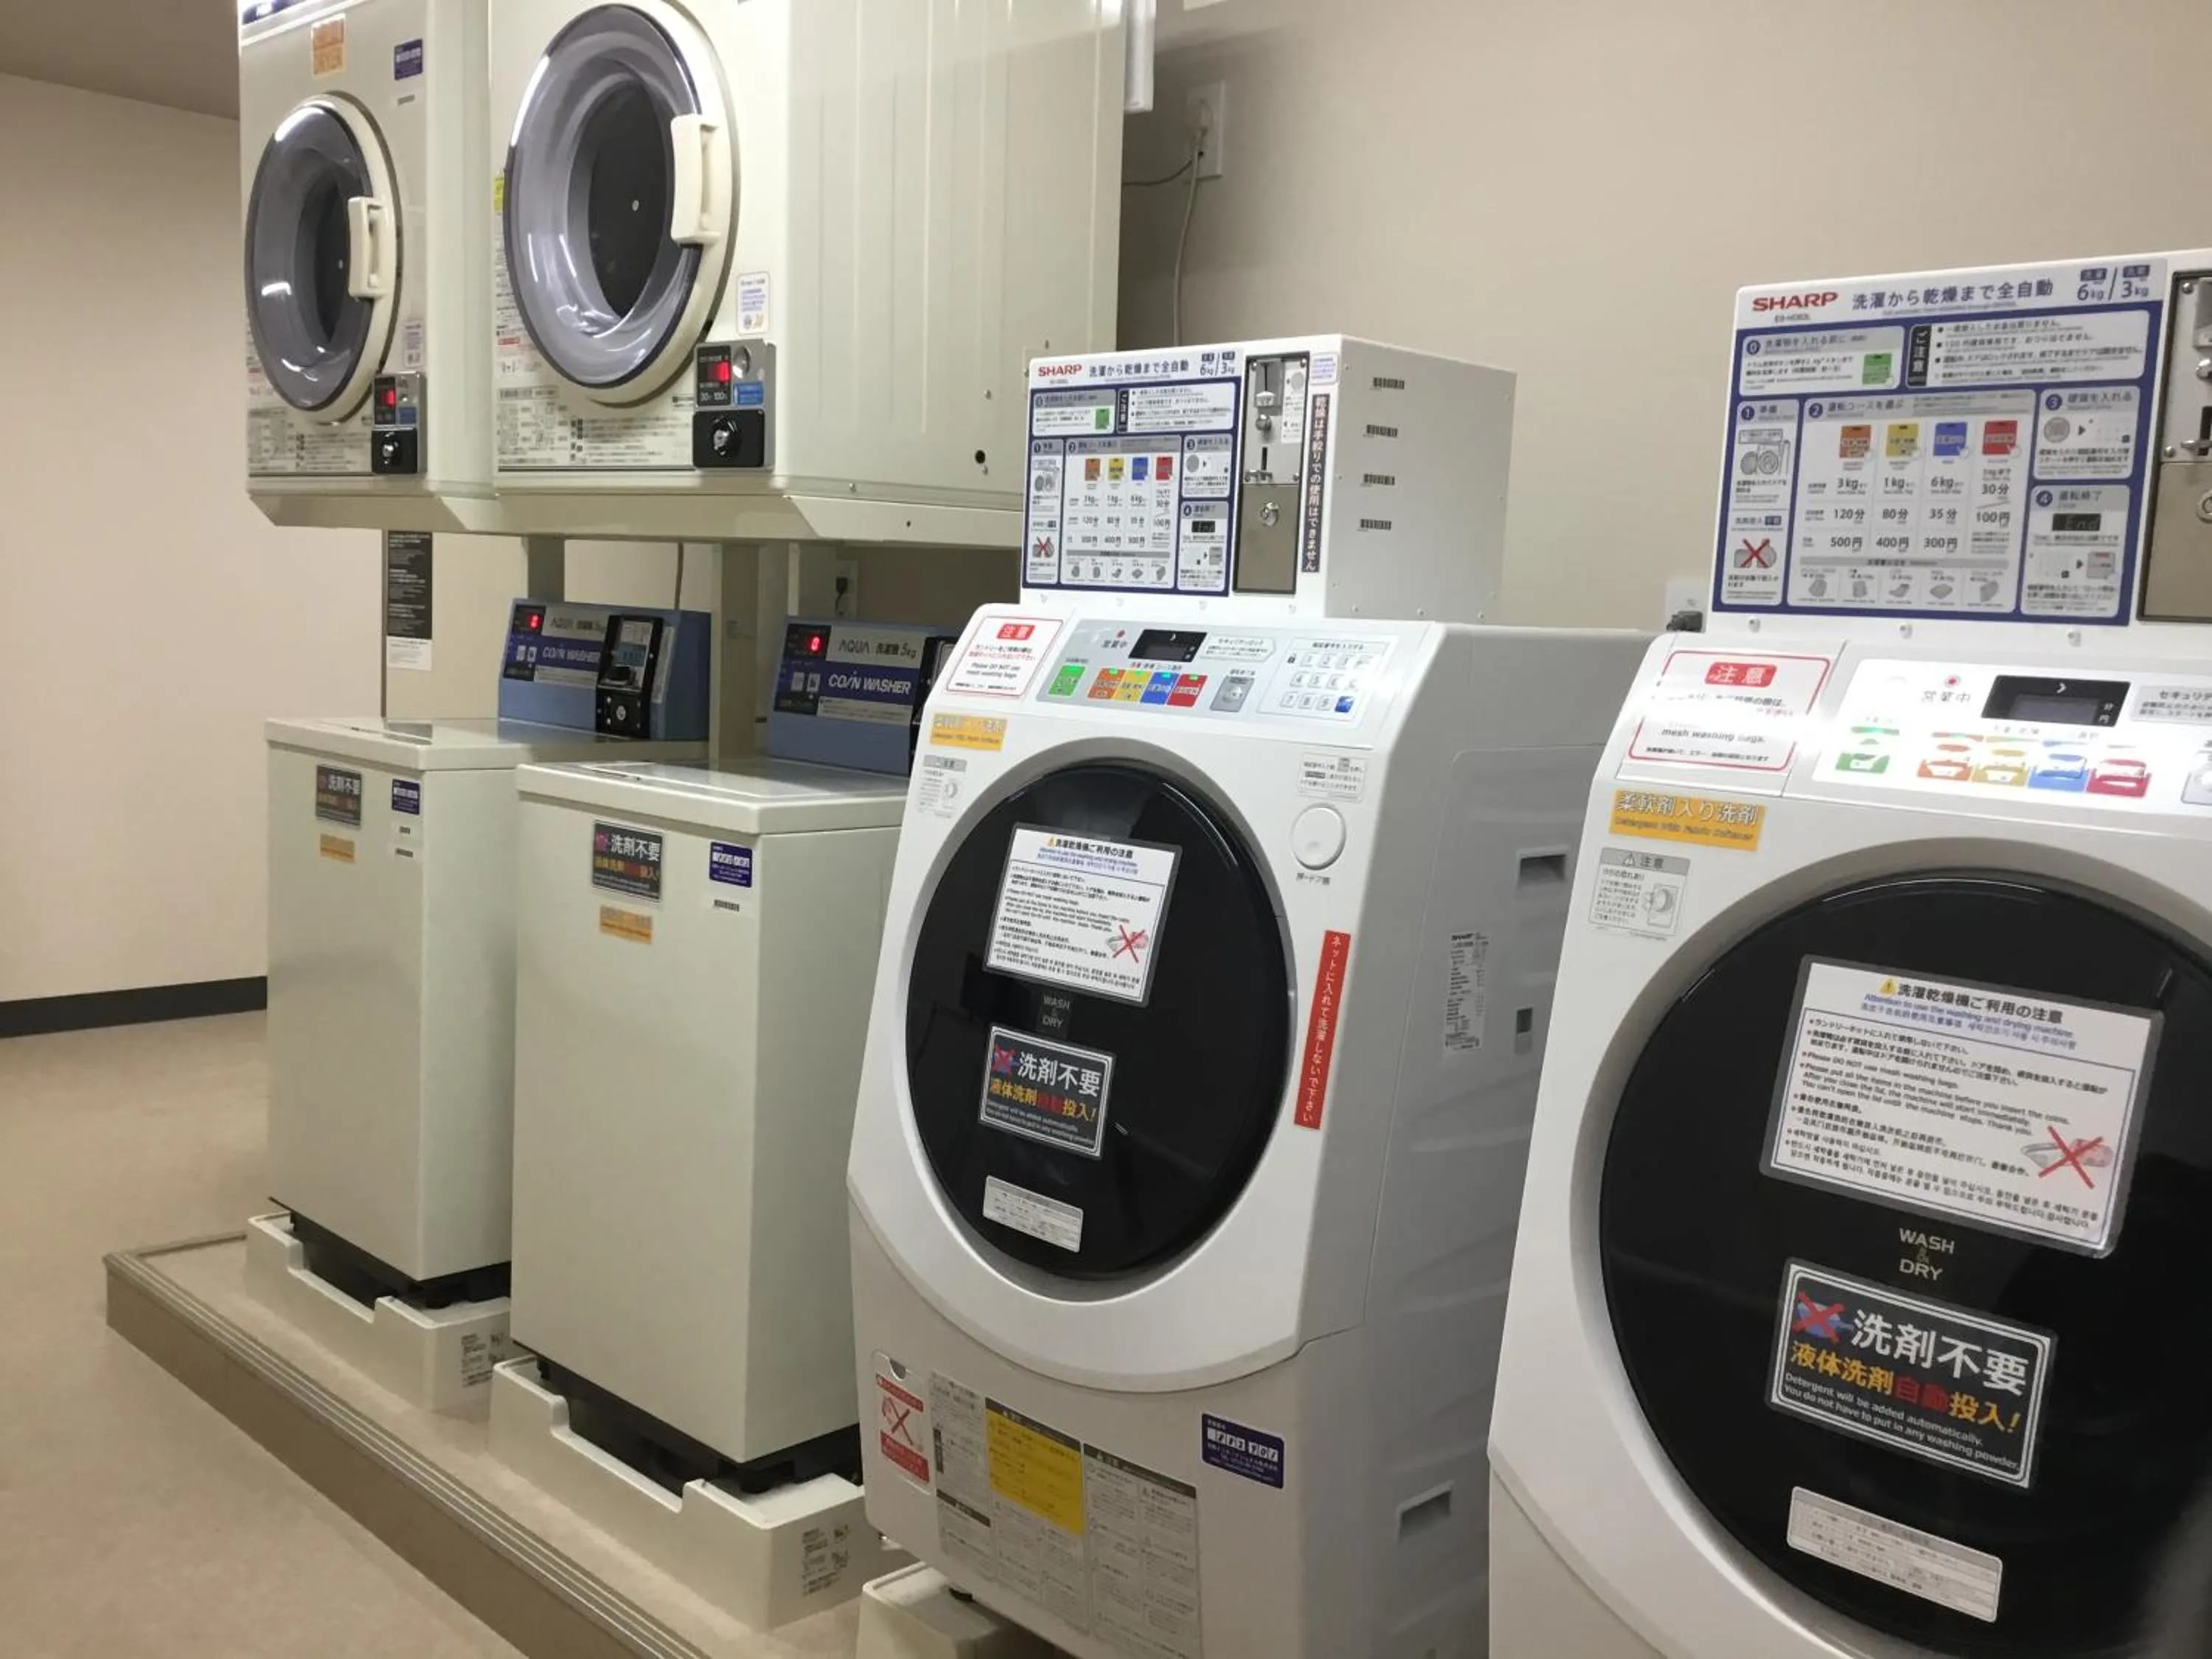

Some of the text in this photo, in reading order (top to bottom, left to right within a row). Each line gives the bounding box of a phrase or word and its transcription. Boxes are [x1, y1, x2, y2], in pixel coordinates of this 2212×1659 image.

[1752, 292, 1838, 311] SHARP
[1852, 278, 2053, 310] 洗濯から乾燥まで全自動
[1038, 364, 1082, 377] SHARP
[838, 639, 869, 653] AQUA
[863, 677, 911, 695] WASHER
[1708, 666, 1766, 684] 注意
[1617, 793, 1759, 826] 柔軟剤入り洗剤
[610, 835, 661, 862] 洗剤不要
[1897, 983, 2063, 1024] 洗濯乾燥機ご利用の注意
[1043, 1016, 1062, 1028] DRY
[1017, 1051, 1102, 1098] 洗剤不要
[1899, 1228, 1955, 1253] WASH
[1899, 1259, 1943, 1281] DRY
[1850, 1308, 2030, 1399] 洗剤不要
[1789, 1339, 2022, 1436] 液体洗剤自動投入!
[1836, 1388, 1854, 1405] will
[1857, 1395, 1869, 1410] be
[1871, 1399, 1905, 1421] added
[1783, 1384, 1801, 1399] You
[1802, 1390, 1816, 1405] do
[1816, 1395, 1834, 1411] not
[1861, 1410, 1873, 1423] to
[1873, 1413, 1891, 1429] put
[1905, 1424, 1924, 1440] any
[1926, 1431, 1973, 1456] washing
